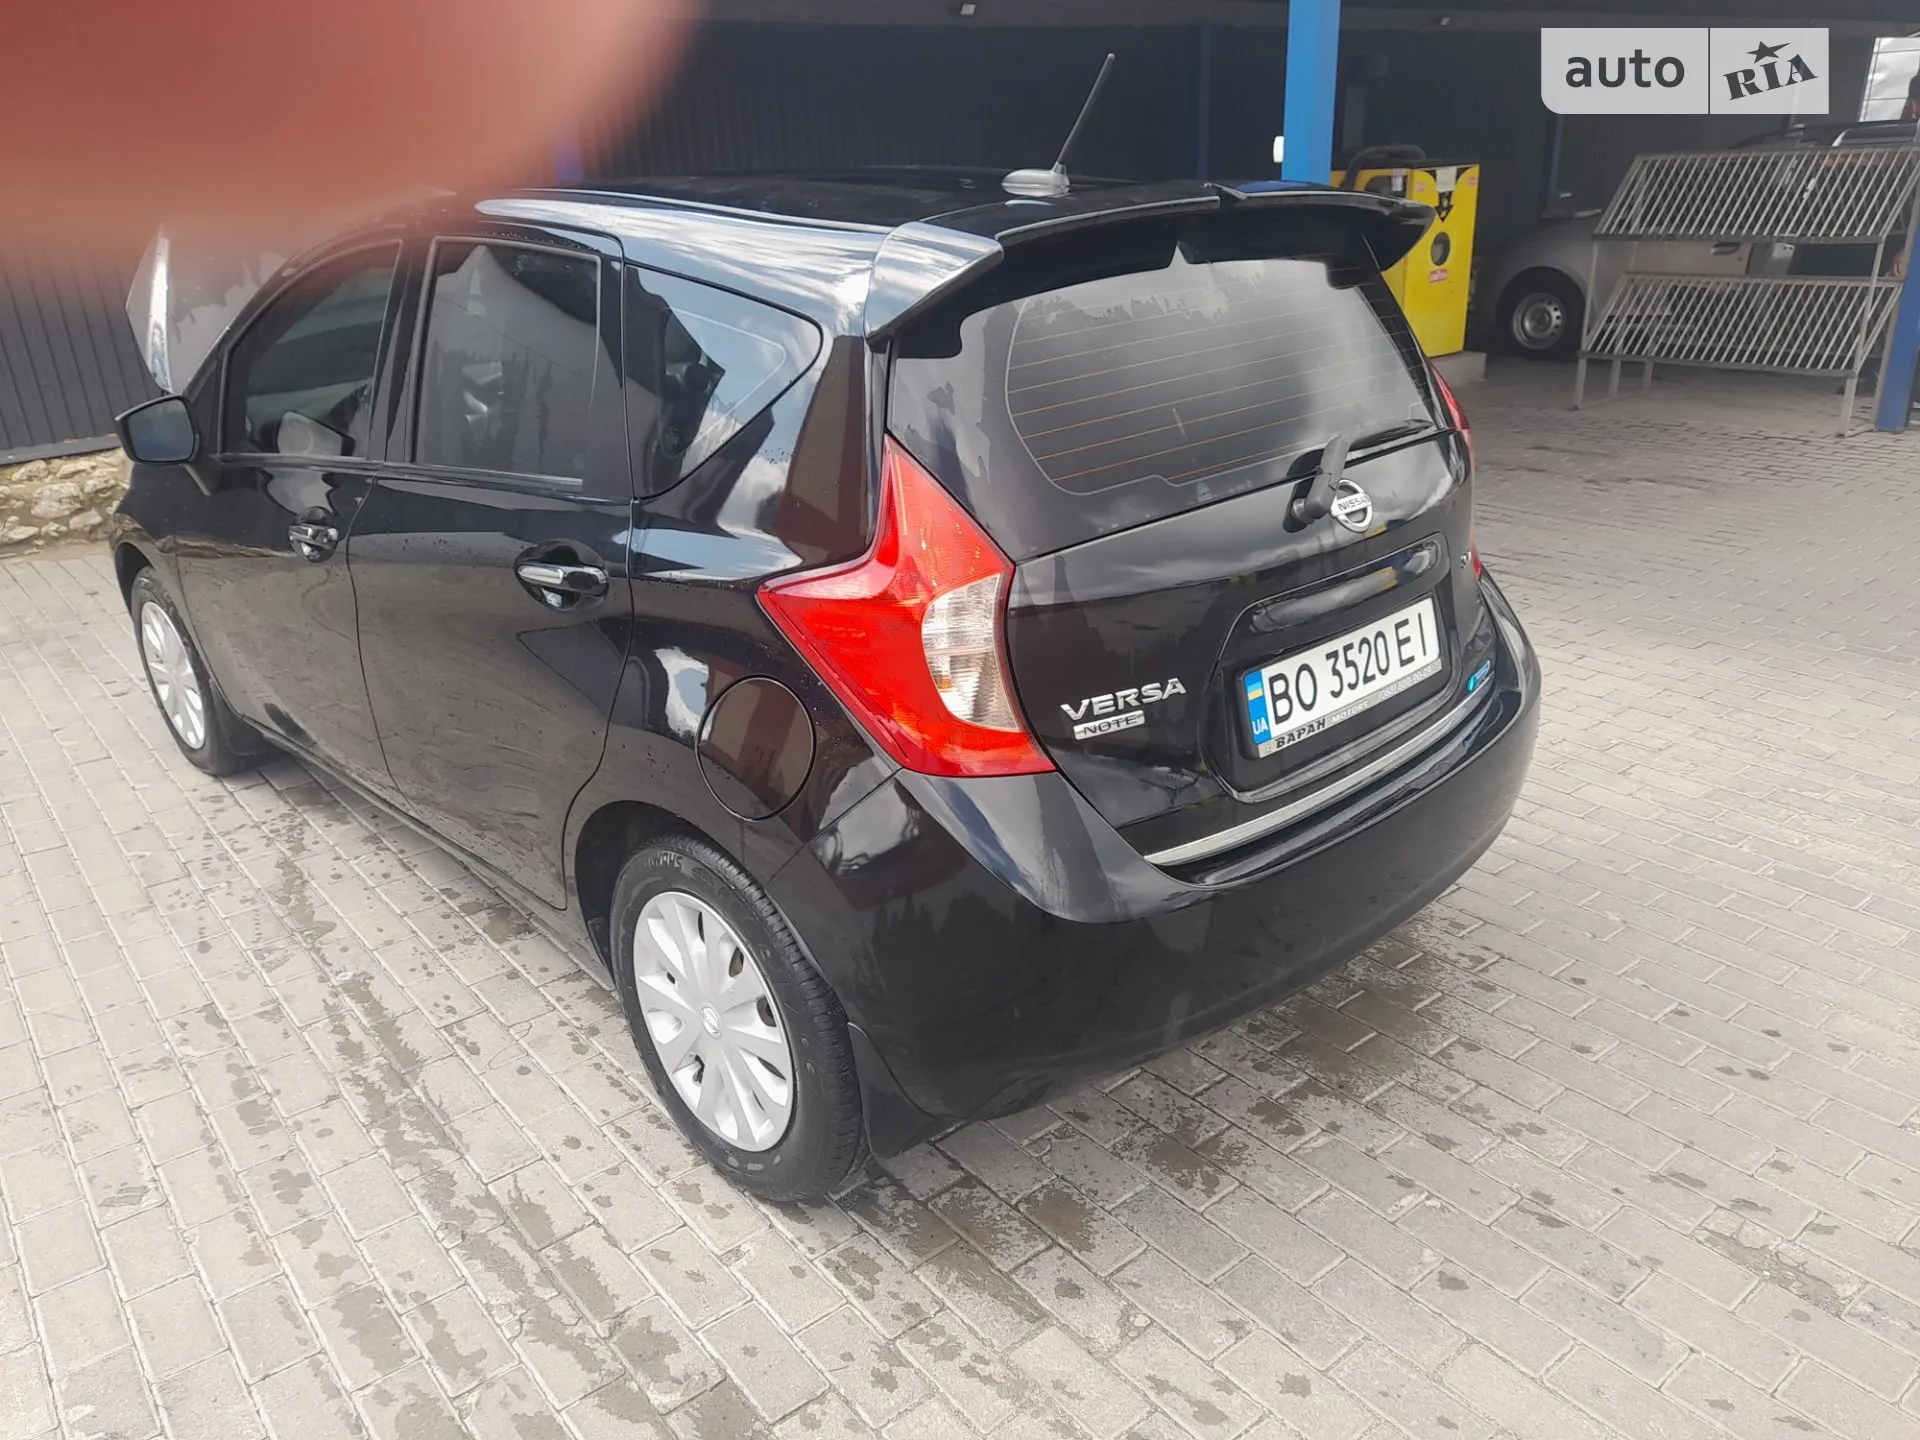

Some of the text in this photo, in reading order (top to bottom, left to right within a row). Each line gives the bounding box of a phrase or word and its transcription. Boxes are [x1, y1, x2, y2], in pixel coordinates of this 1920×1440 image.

[1268, 612, 1427, 725] BO 3520 EI
[1060, 677, 1187, 721] VERSA
[1083, 714, 1139, 735] NOTE
[1252, 717, 1269, 735] UA
